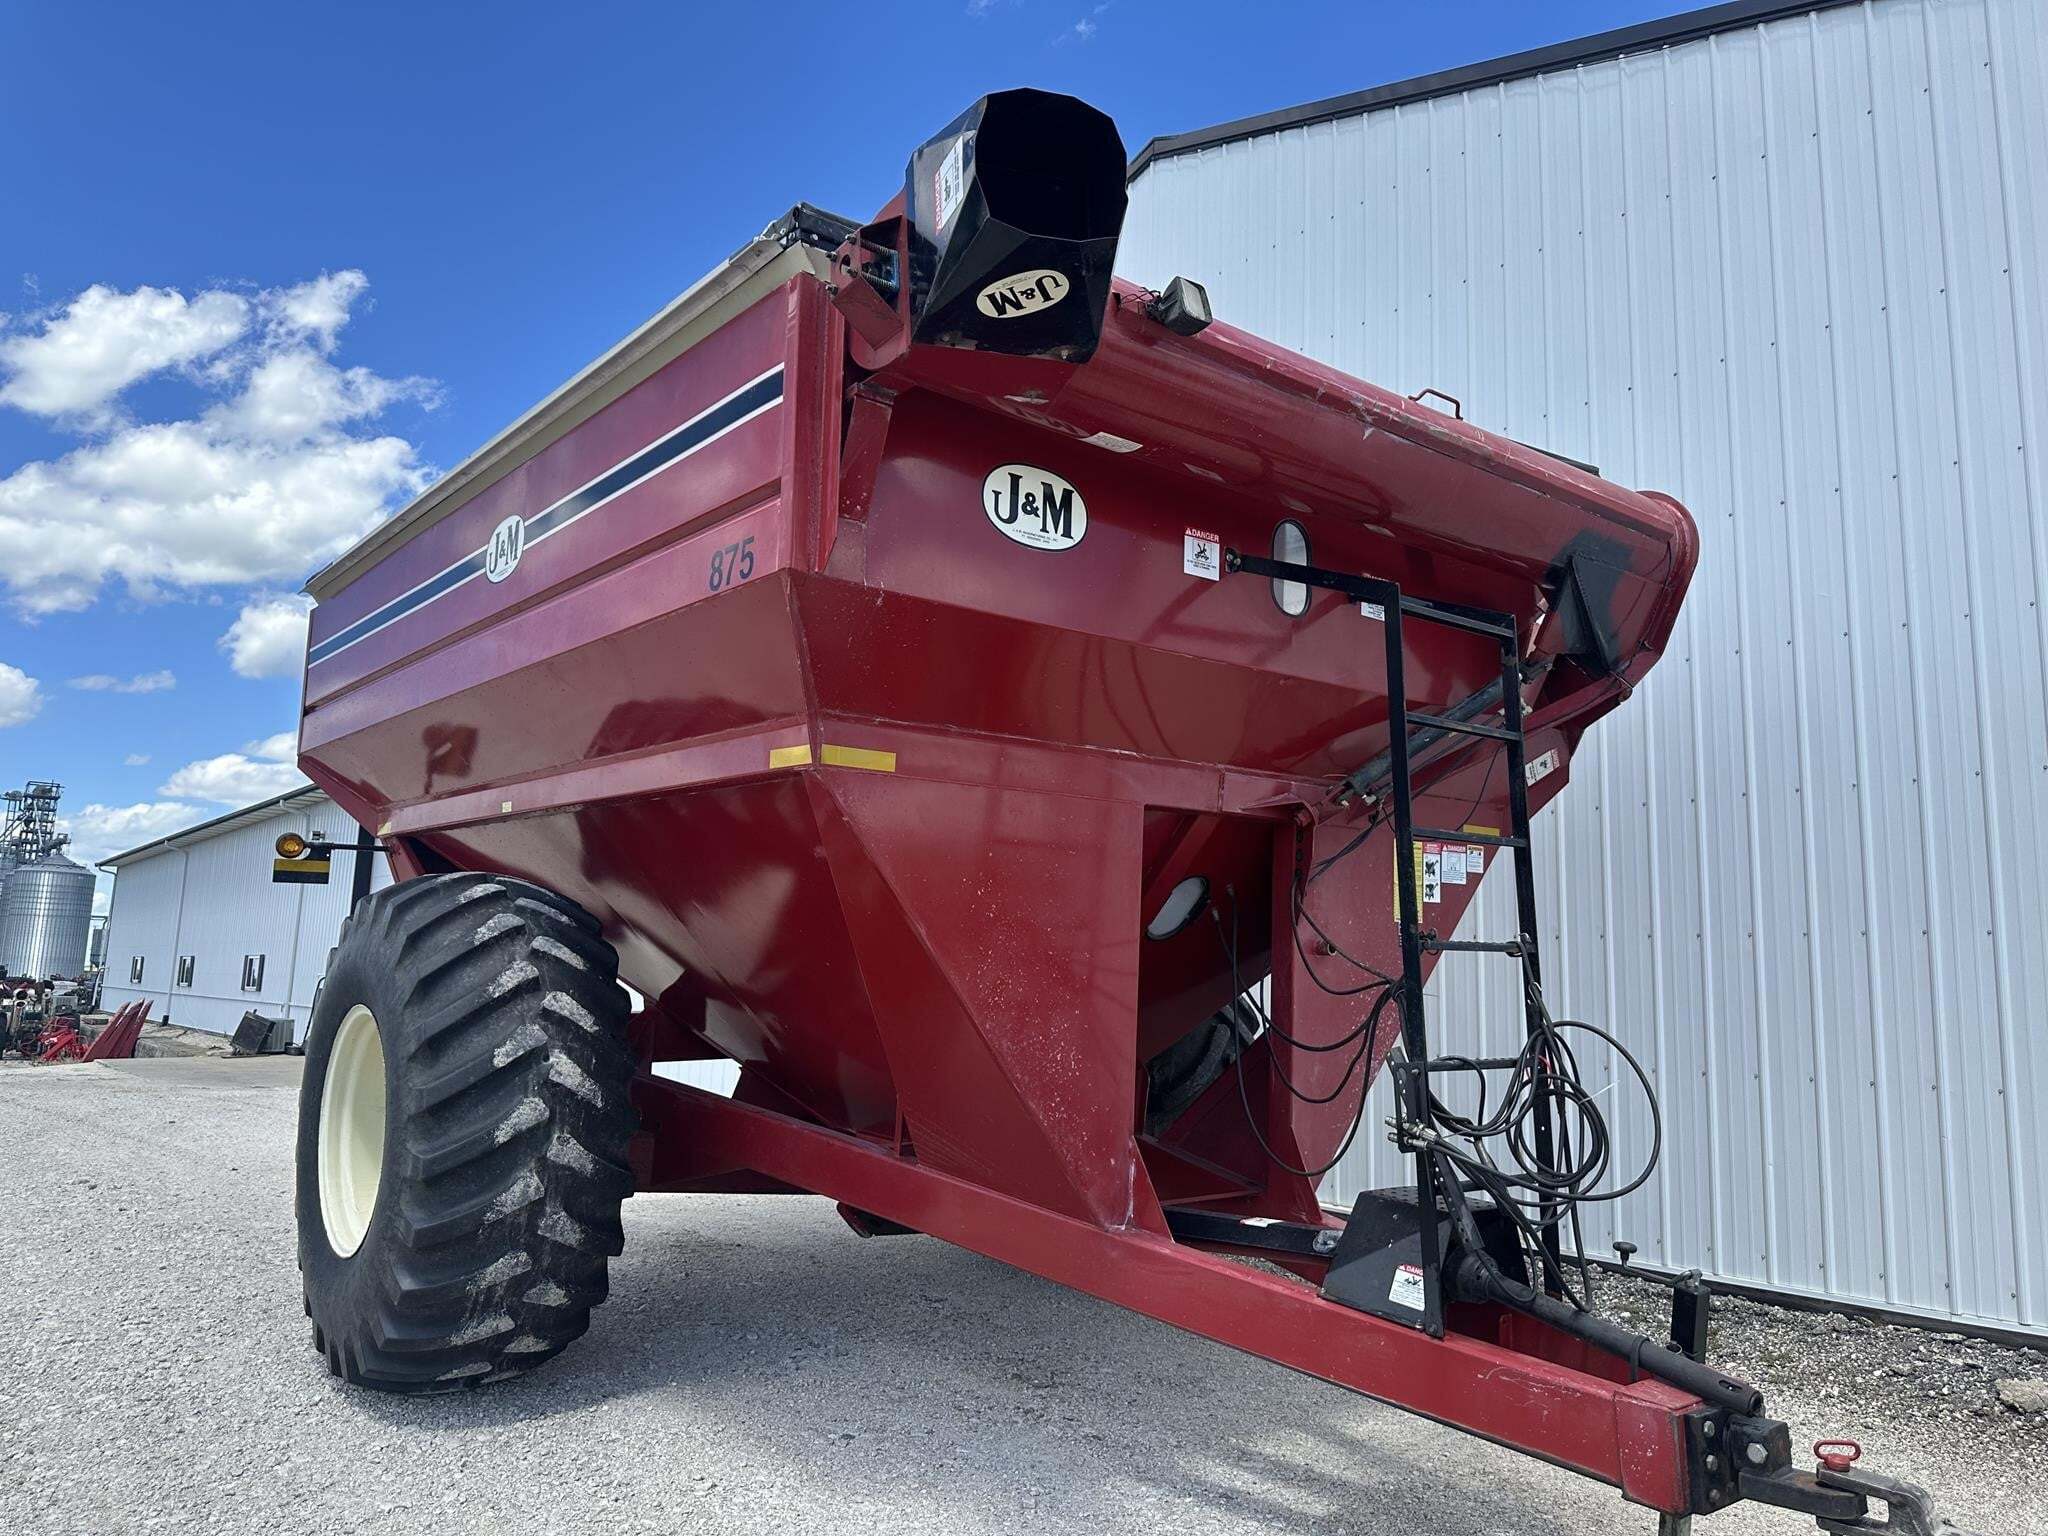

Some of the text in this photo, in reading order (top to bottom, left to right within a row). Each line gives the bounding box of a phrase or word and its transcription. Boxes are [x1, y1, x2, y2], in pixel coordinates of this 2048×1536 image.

[984, 275, 1063, 316] J&M
[992, 472, 1074, 540] J&M
[489, 520, 521, 573] J&M
[1191, 529, 1219, 542] DANGER
[709, 536, 754, 591] 875
[1406, 1266, 1423, 1275] DANG
